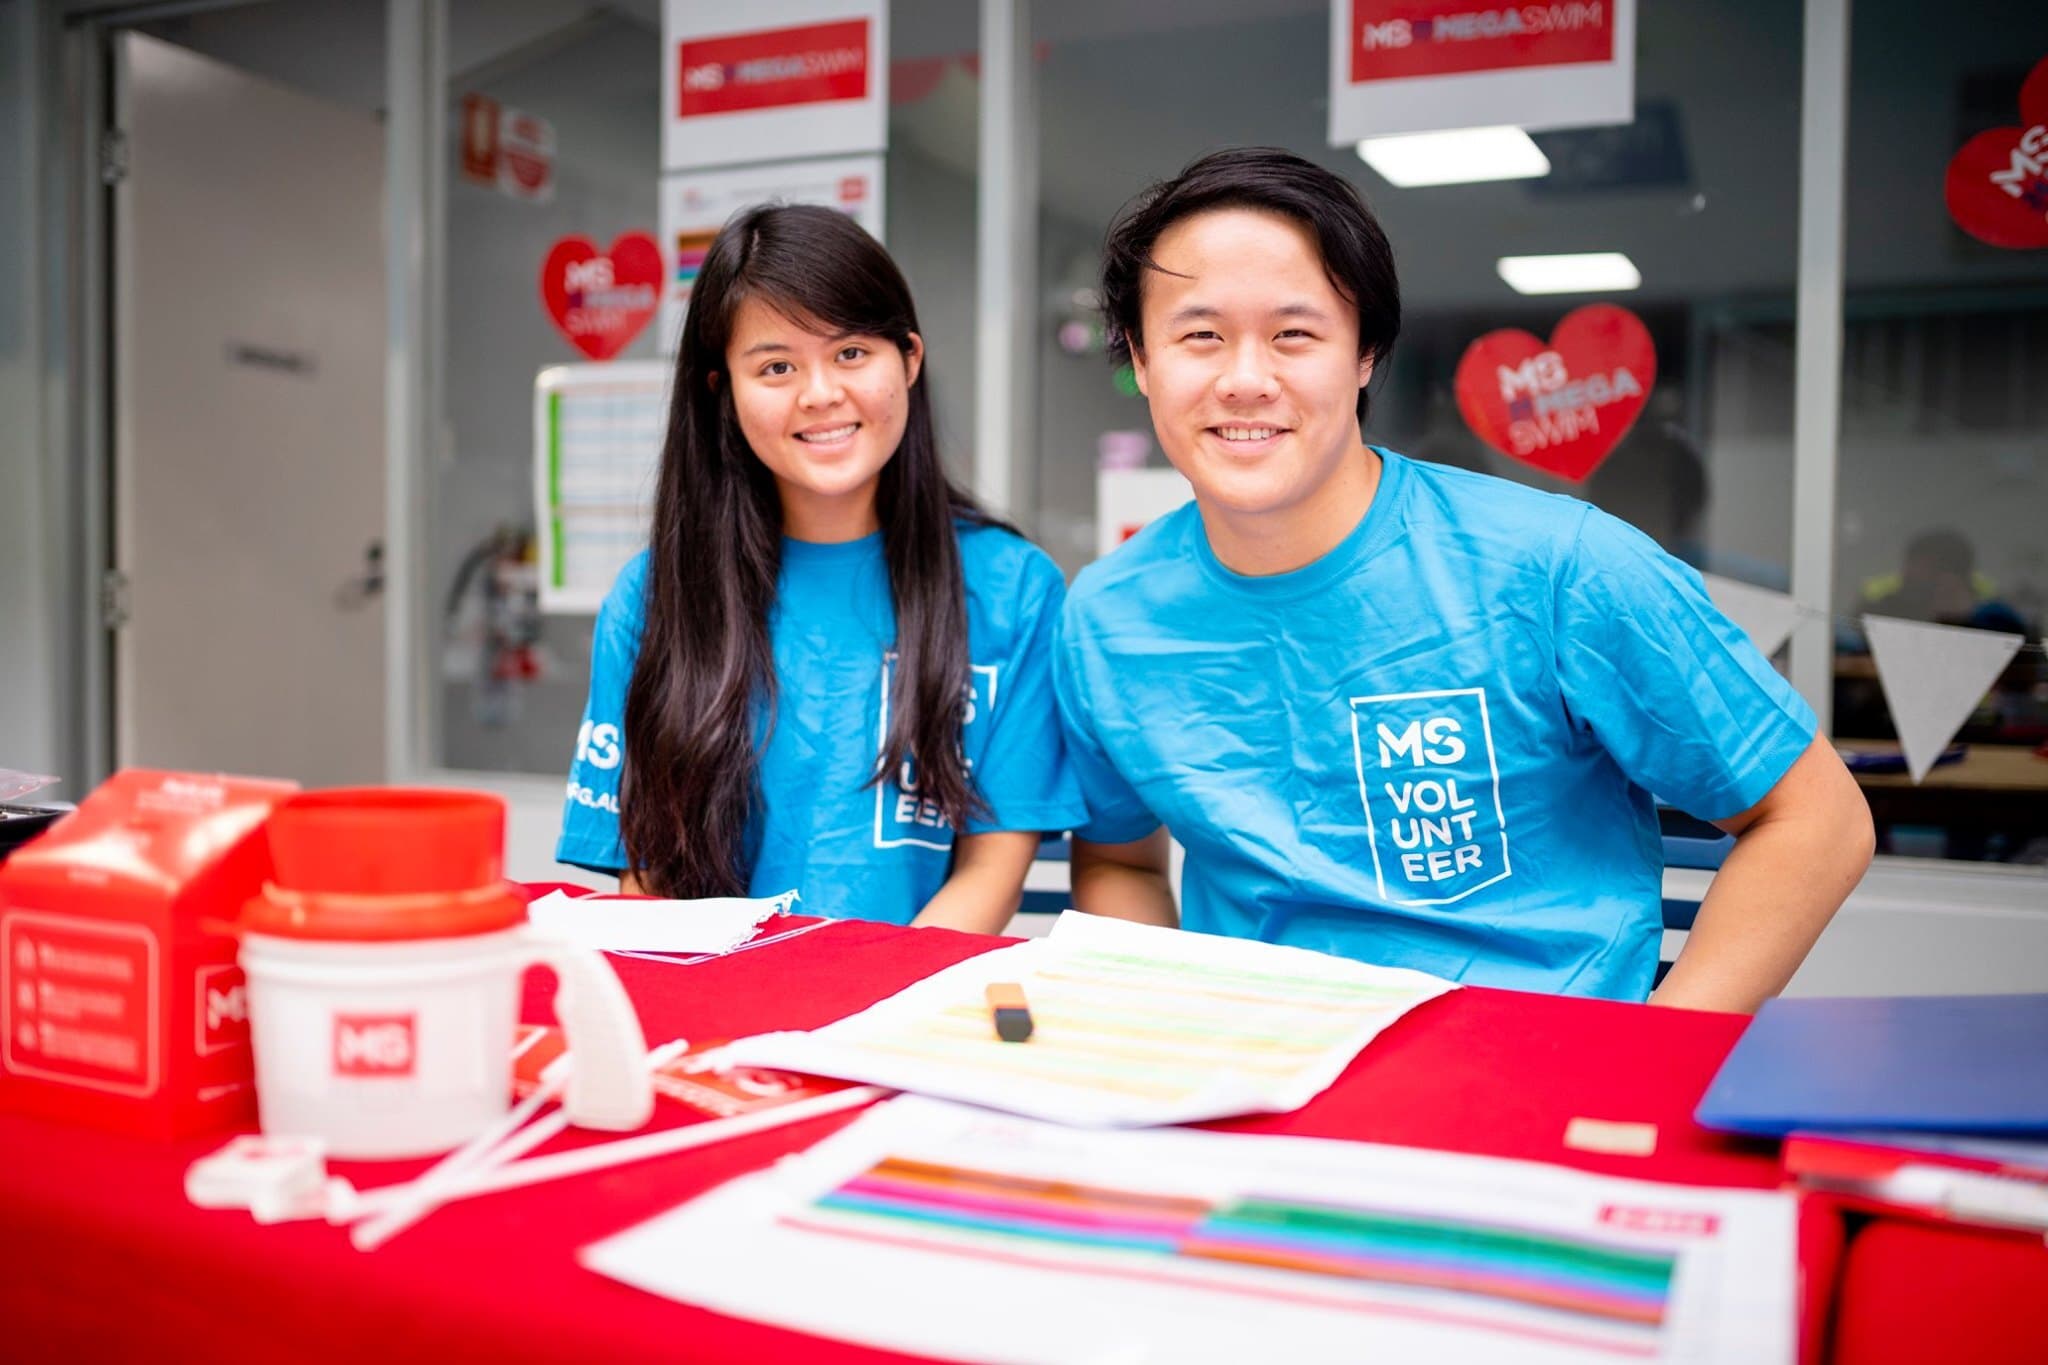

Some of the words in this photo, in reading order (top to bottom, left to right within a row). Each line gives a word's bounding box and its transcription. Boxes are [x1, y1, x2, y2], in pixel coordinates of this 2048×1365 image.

[1363, 19, 1412, 51] MS
[564, 258, 615, 294] MS
[1498, 352, 1567, 402] MS
[1536, 366, 1642, 416] MEGA
[1509, 405, 1600, 455] SWIM
[1376, 717, 1466, 768] MS
[1384, 778, 1475, 814] VOL
[1391, 810, 1477, 849] UNT
[1400, 844, 1483, 882] EER
[339, 1022, 409, 1068] MS
